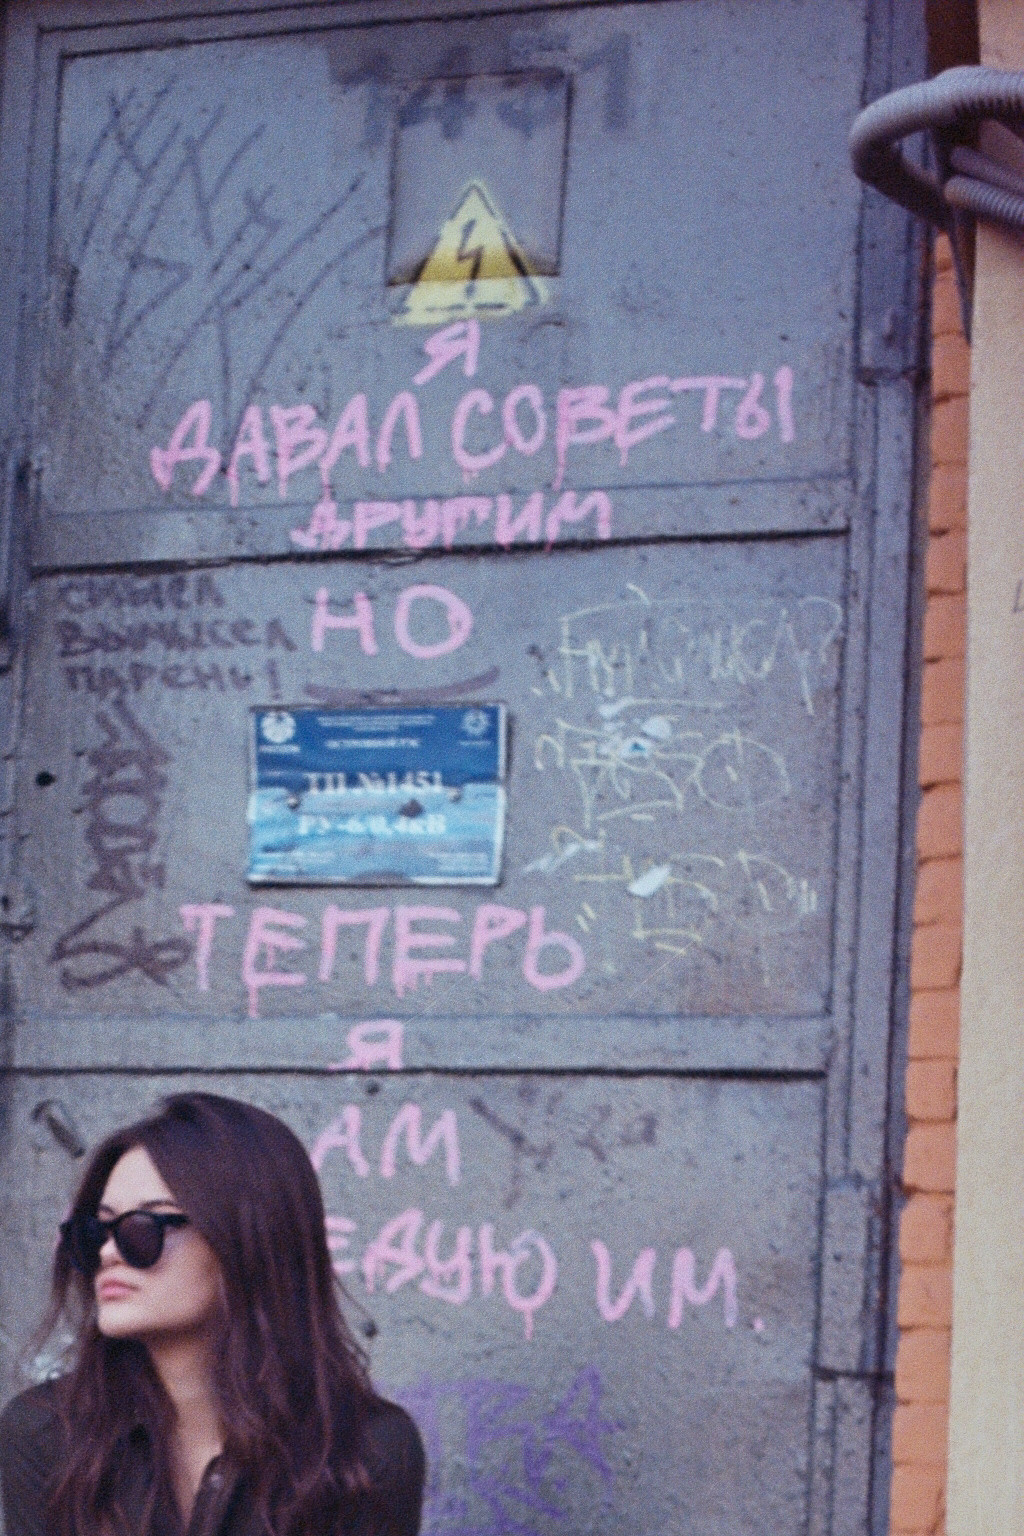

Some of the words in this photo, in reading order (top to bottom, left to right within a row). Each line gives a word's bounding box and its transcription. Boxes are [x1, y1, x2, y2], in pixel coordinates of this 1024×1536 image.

[414, 319, 480, 385] Я
[150, 392, 424, 505] ДАВАЛ
[451, 366, 796, 488] СОВЕТЫ
[290, 489, 613, 551] ДРУГИМ
[310, 584, 475, 660] НО
[179, 903, 585, 1017] ТЕПЕРЬ
[327, 1019, 404, 1071] Я
[310, 1101, 462, 1187] АМ
[324, 1208, 558, 1340] ЕДУЮ
